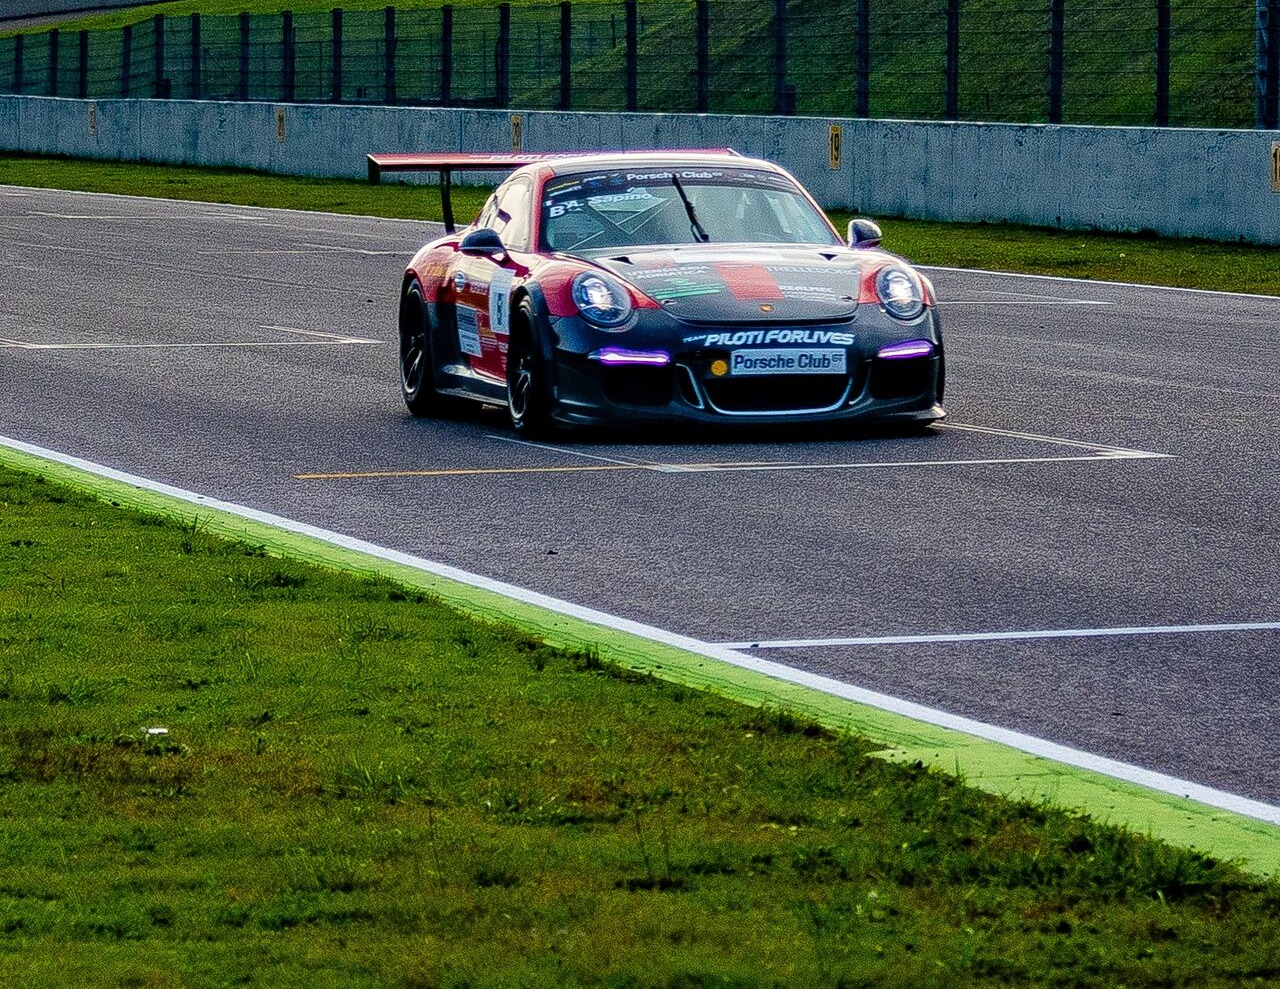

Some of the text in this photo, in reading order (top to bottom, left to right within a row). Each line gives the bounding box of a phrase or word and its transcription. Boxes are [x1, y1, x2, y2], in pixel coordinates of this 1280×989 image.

[830, 132, 840, 162] 19
[626, 172, 680, 182] Porsche
[681, 171, 713, 179] Club
[704, 330, 764, 347] PILOTI
[733, 355, 795, 370] Porsche
[798, 353, 831, 369] Club
